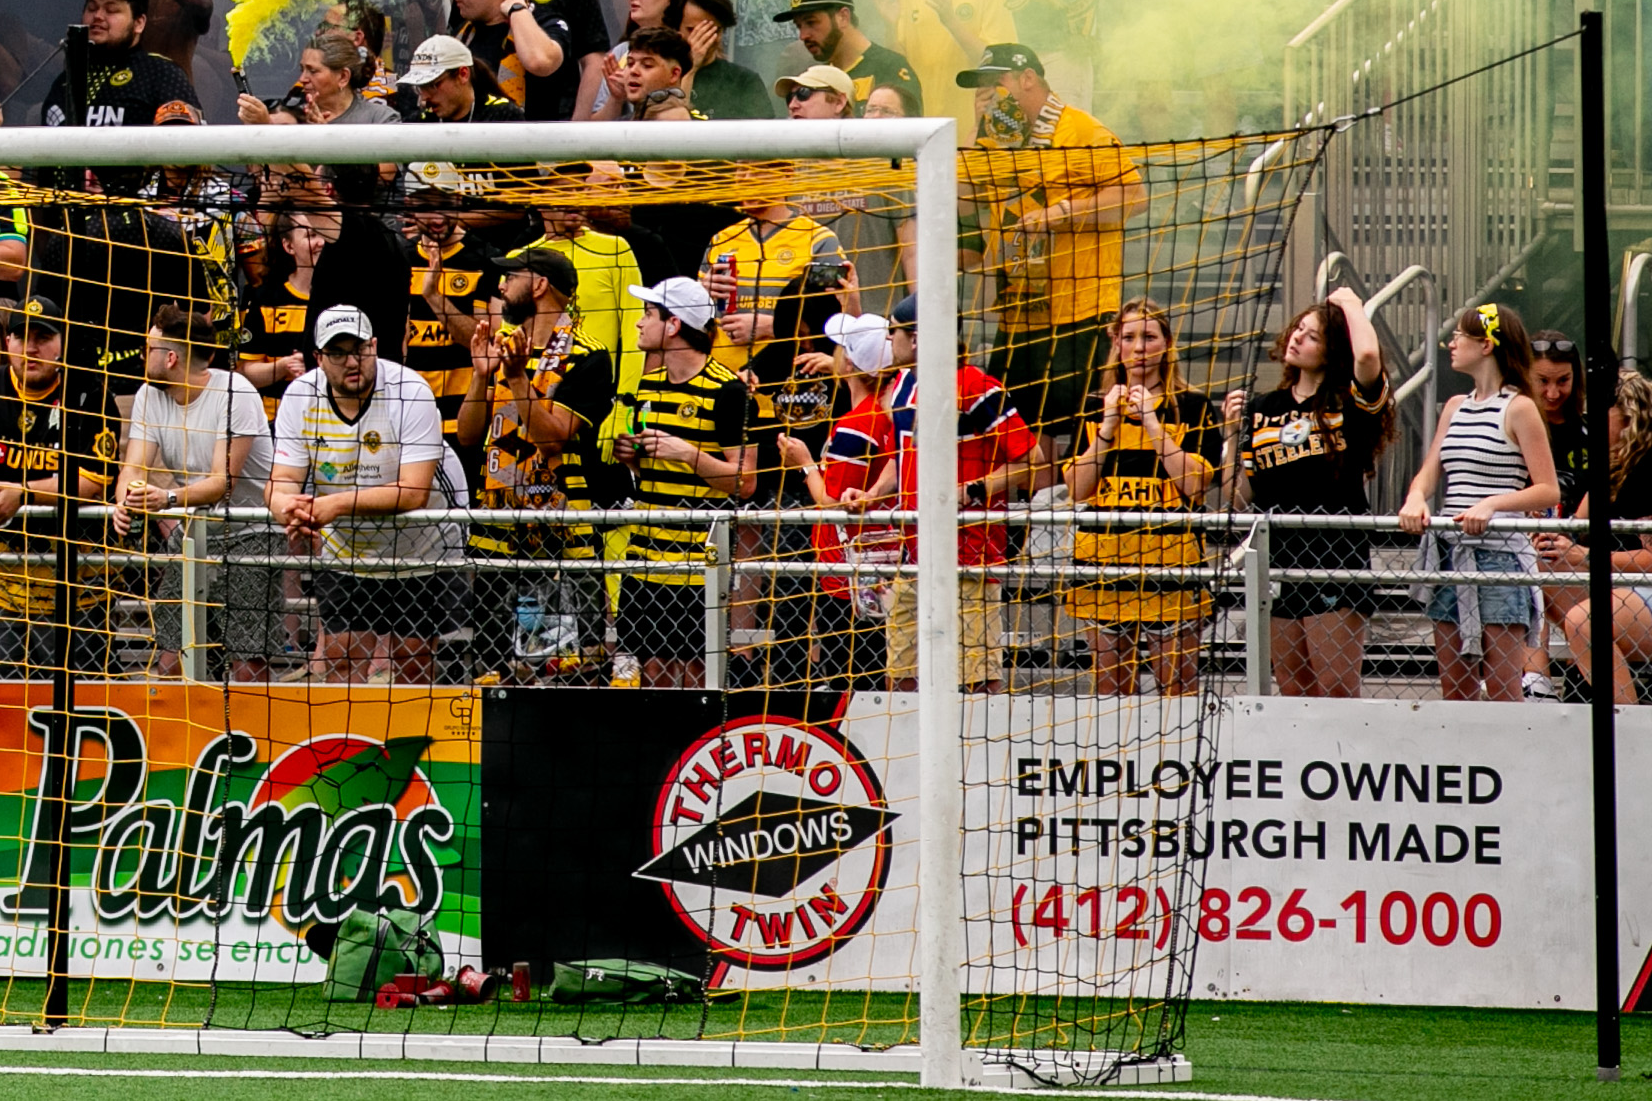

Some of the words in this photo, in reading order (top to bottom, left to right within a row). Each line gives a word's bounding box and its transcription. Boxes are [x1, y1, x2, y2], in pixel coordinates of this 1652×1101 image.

[86, 105, 125, 127] HN
[422, 323, 453, 346] AH
[669, 731, 843, 827] THERMO
[1017, 758, 1284, 800] EMPLOYEE
[1300, 760, 1503, 805] OWNED
[0, 705, 456, 924] Palmas
[682, 810, 853, 875] WINDOWS
[1017, 817, 1327, 860] PITTSBURGH
[1348, 822, 1502, 866] MADE
[730, 882, 849, 950] TWIN
[1012, 883, 1172, 951] (412)
[1198, 887, 1503, 949] 826-1000
[179, 940, 216, 961] se
